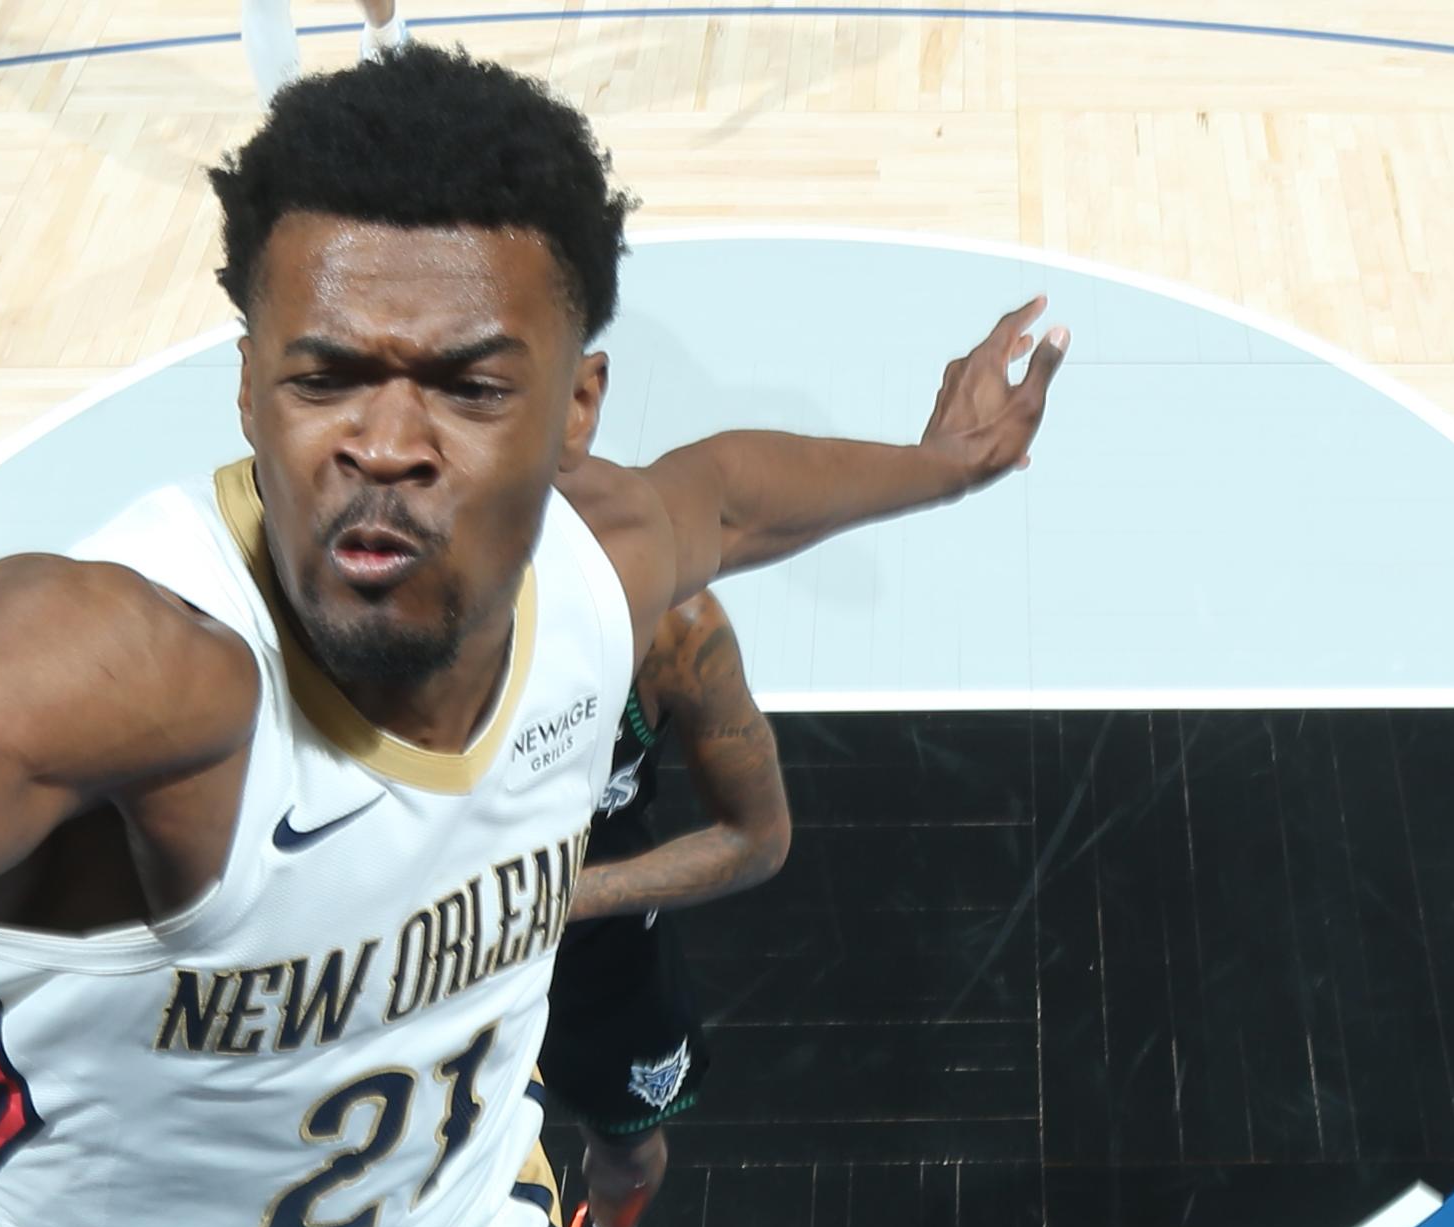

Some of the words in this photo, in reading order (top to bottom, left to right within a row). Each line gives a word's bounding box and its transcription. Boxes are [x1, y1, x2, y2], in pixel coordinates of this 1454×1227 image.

[531, 736, 574, 772] GRILLS
[153, 938, 382, 1055] NEW
[383, 822, 591, 1025] ORLEAN
